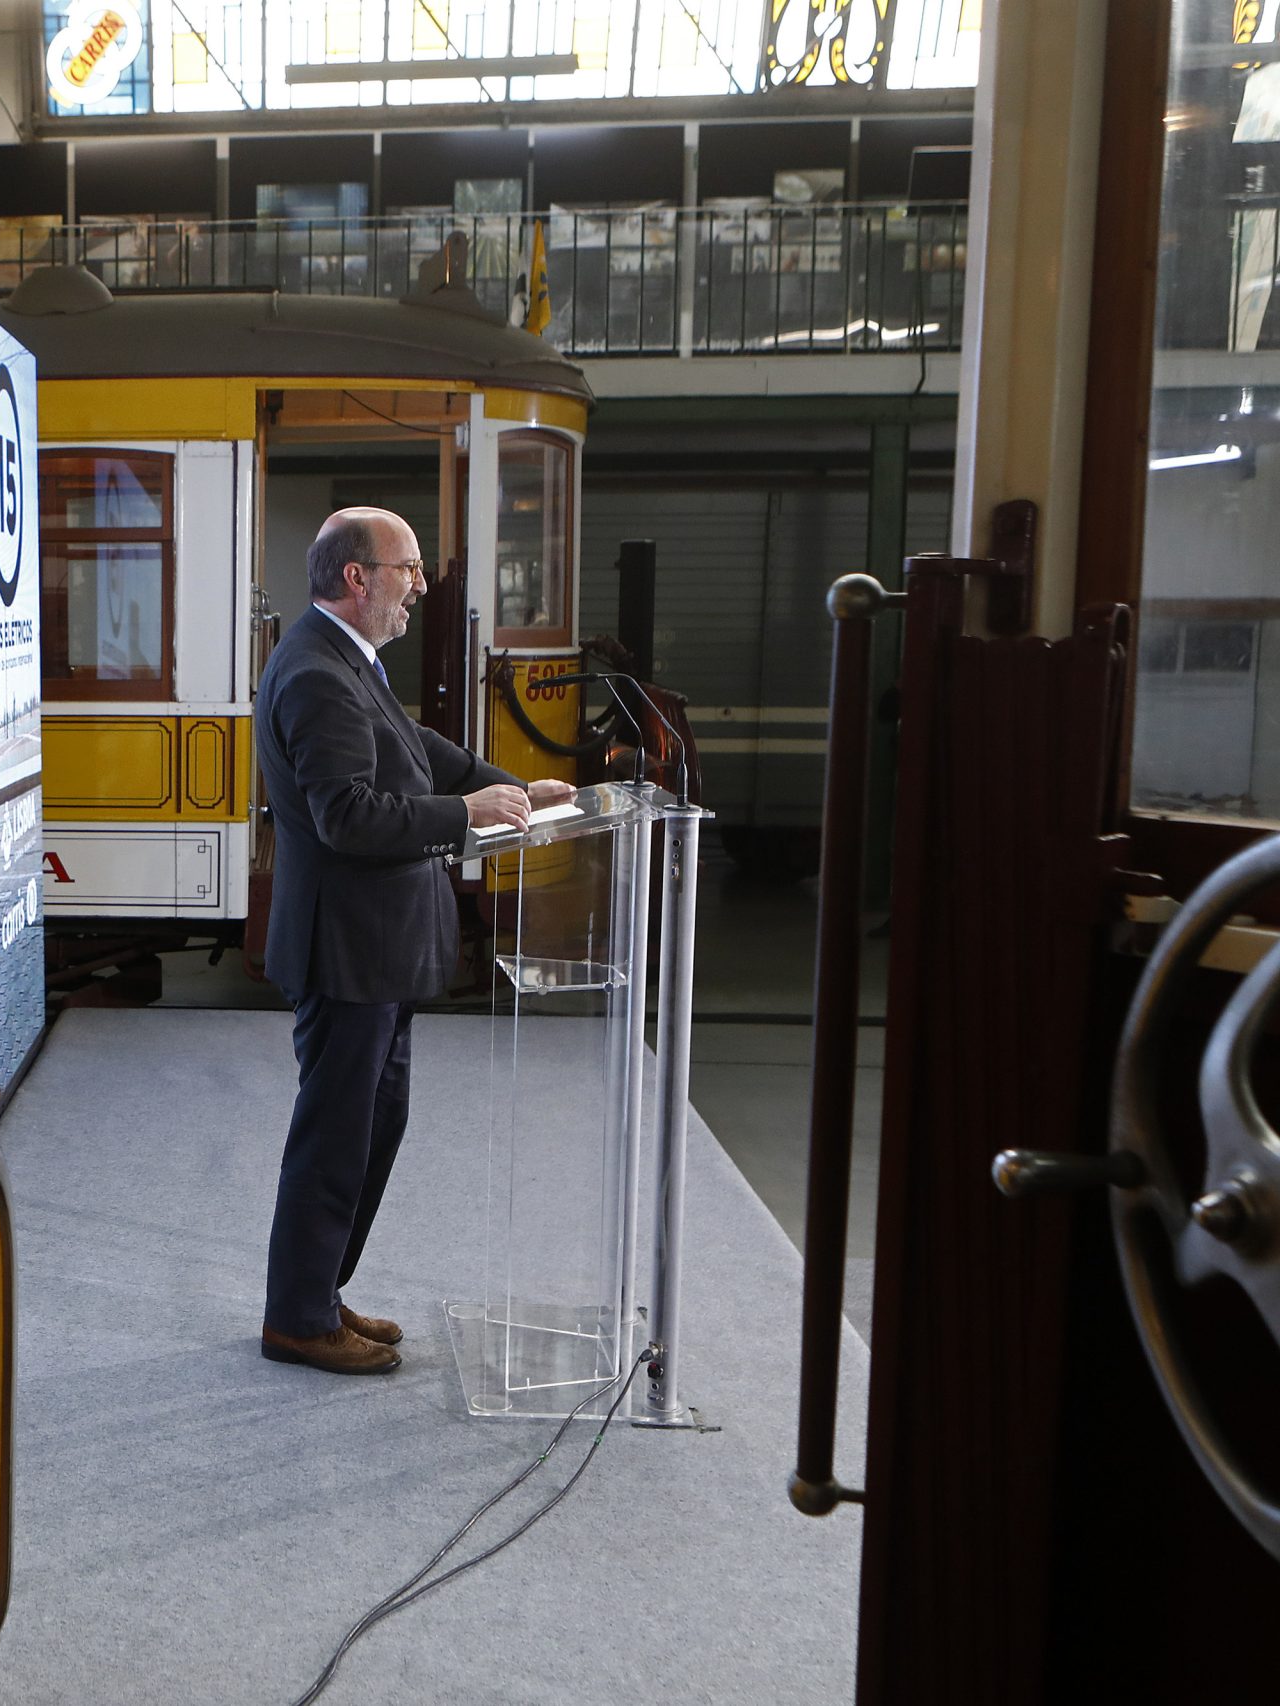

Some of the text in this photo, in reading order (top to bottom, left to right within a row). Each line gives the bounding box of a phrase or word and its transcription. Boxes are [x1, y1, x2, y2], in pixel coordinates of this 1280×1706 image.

[70, 14, 124, 82] CARRIS
[5, 613, 33, 648] ELÉTRICOS
[13, 792, 36, 842] LISBOA
